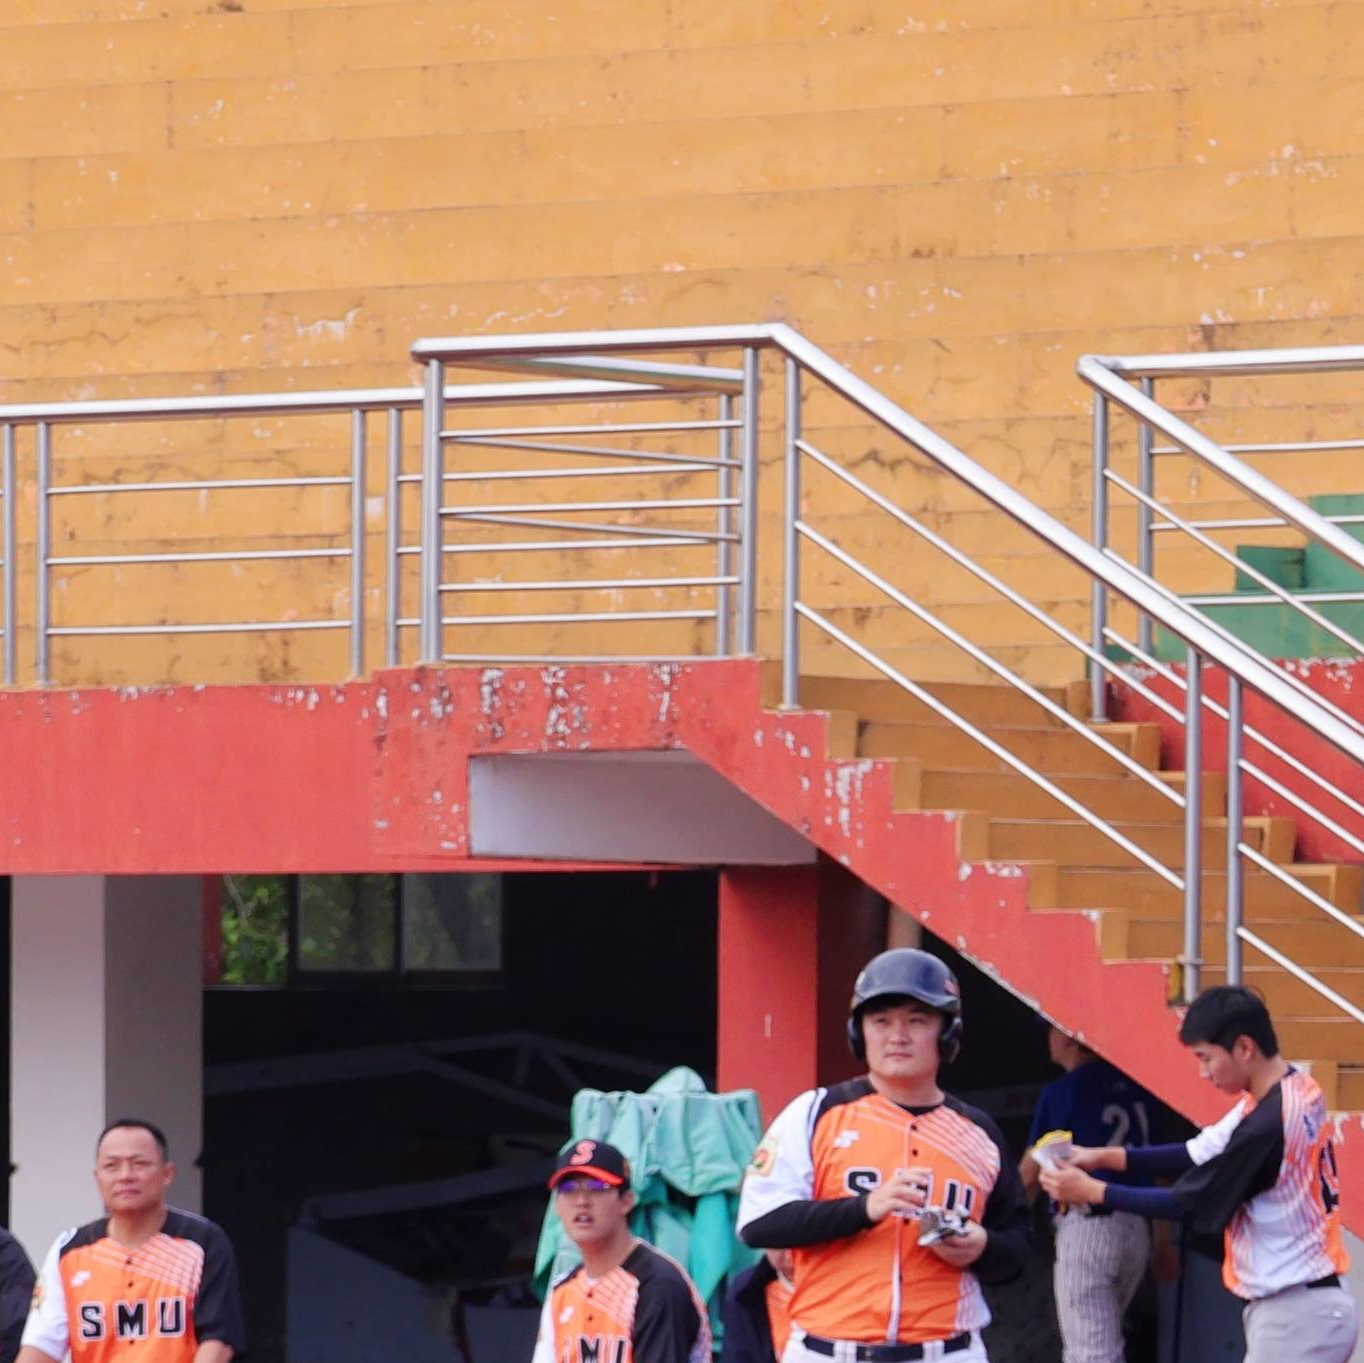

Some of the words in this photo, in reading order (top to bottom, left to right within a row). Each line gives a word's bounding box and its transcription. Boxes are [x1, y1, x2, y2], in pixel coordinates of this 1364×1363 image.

[570, 1140, 596, 1165] S
[844, 1166, 975, 1219] SU
[77, 1296, 186, 1343] SMU
